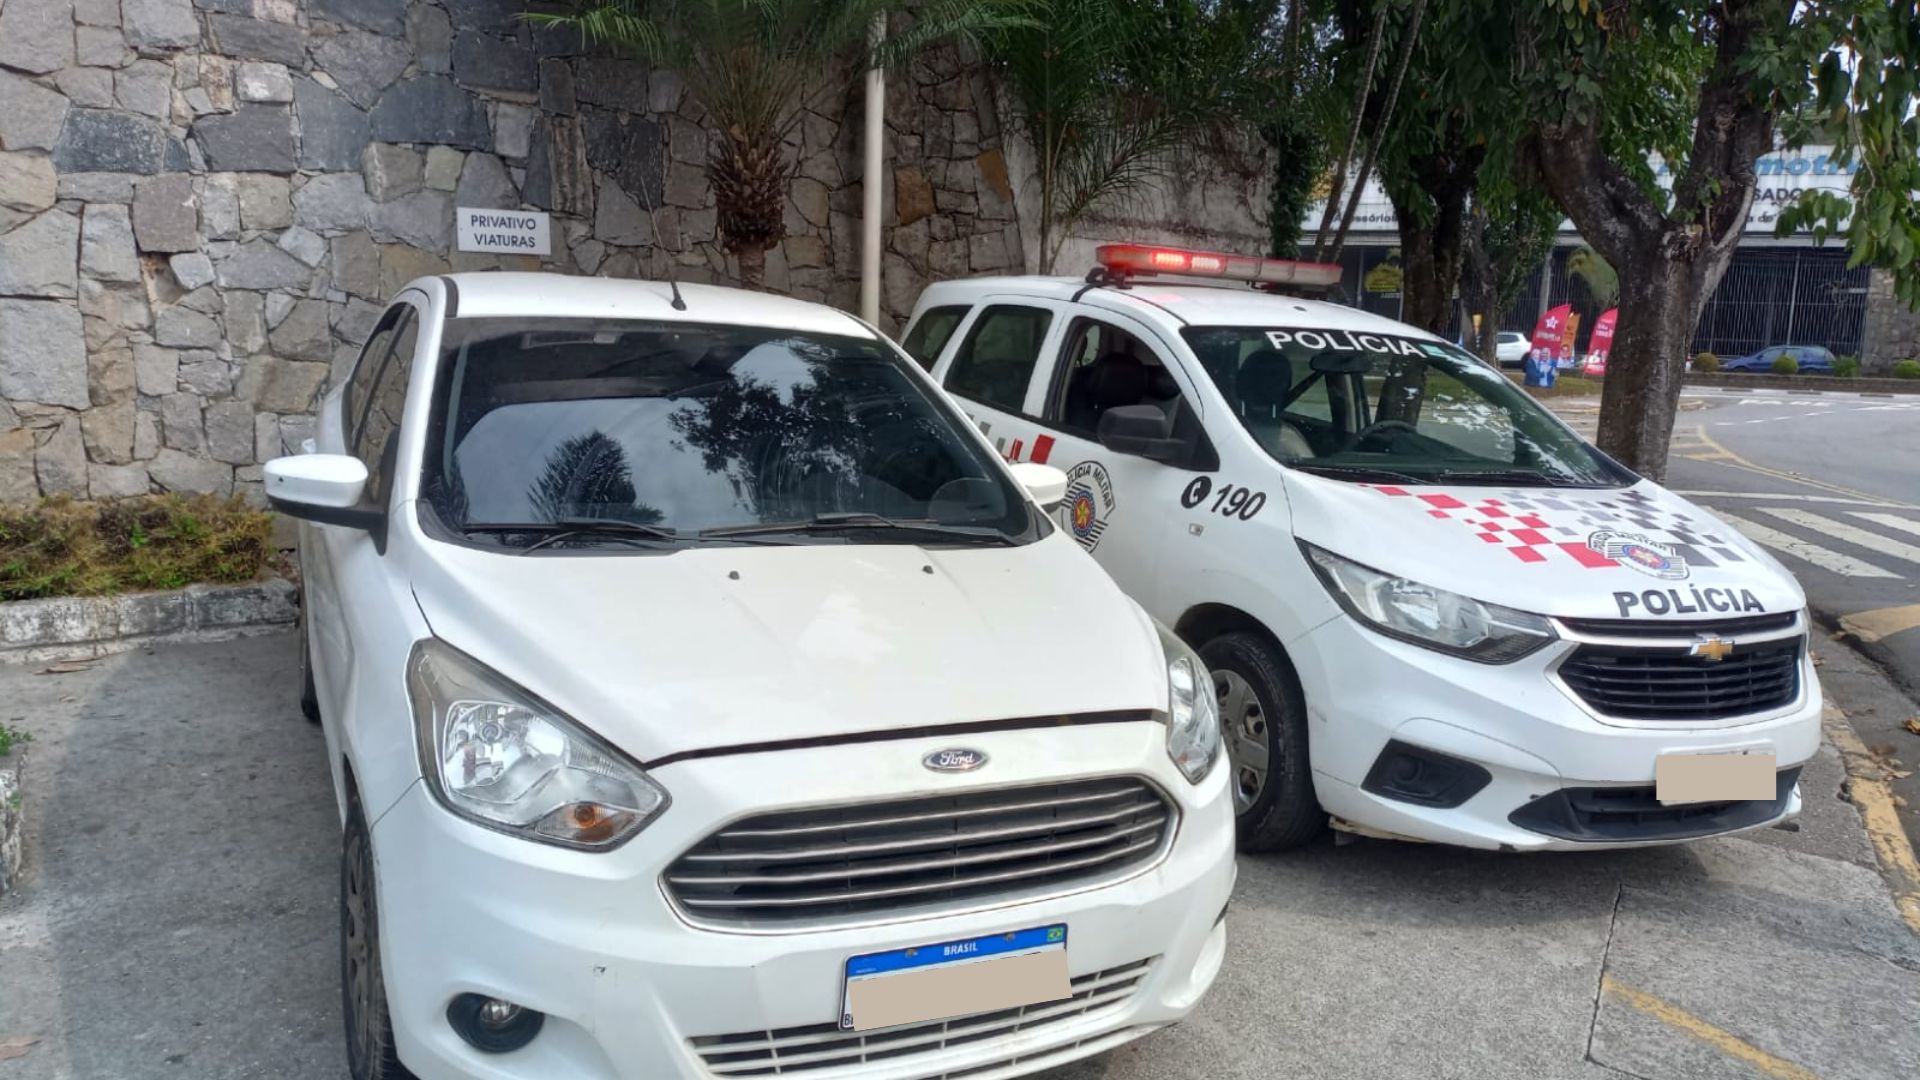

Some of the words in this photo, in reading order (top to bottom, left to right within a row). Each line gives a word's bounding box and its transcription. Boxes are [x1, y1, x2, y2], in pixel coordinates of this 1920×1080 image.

[471, 215, 536, 230] PRIVATIVO
[474, 233, 535, 248] VIATURAS
[1265, 330, 1428, 358] POLÍCIA
[1211, 483, 1267, 521] 190
[1613, 583, 1766, 617] POLÍCIA
[940, 751, 976, 766] Ford
[944, 941, 978, 956] BRASIL
